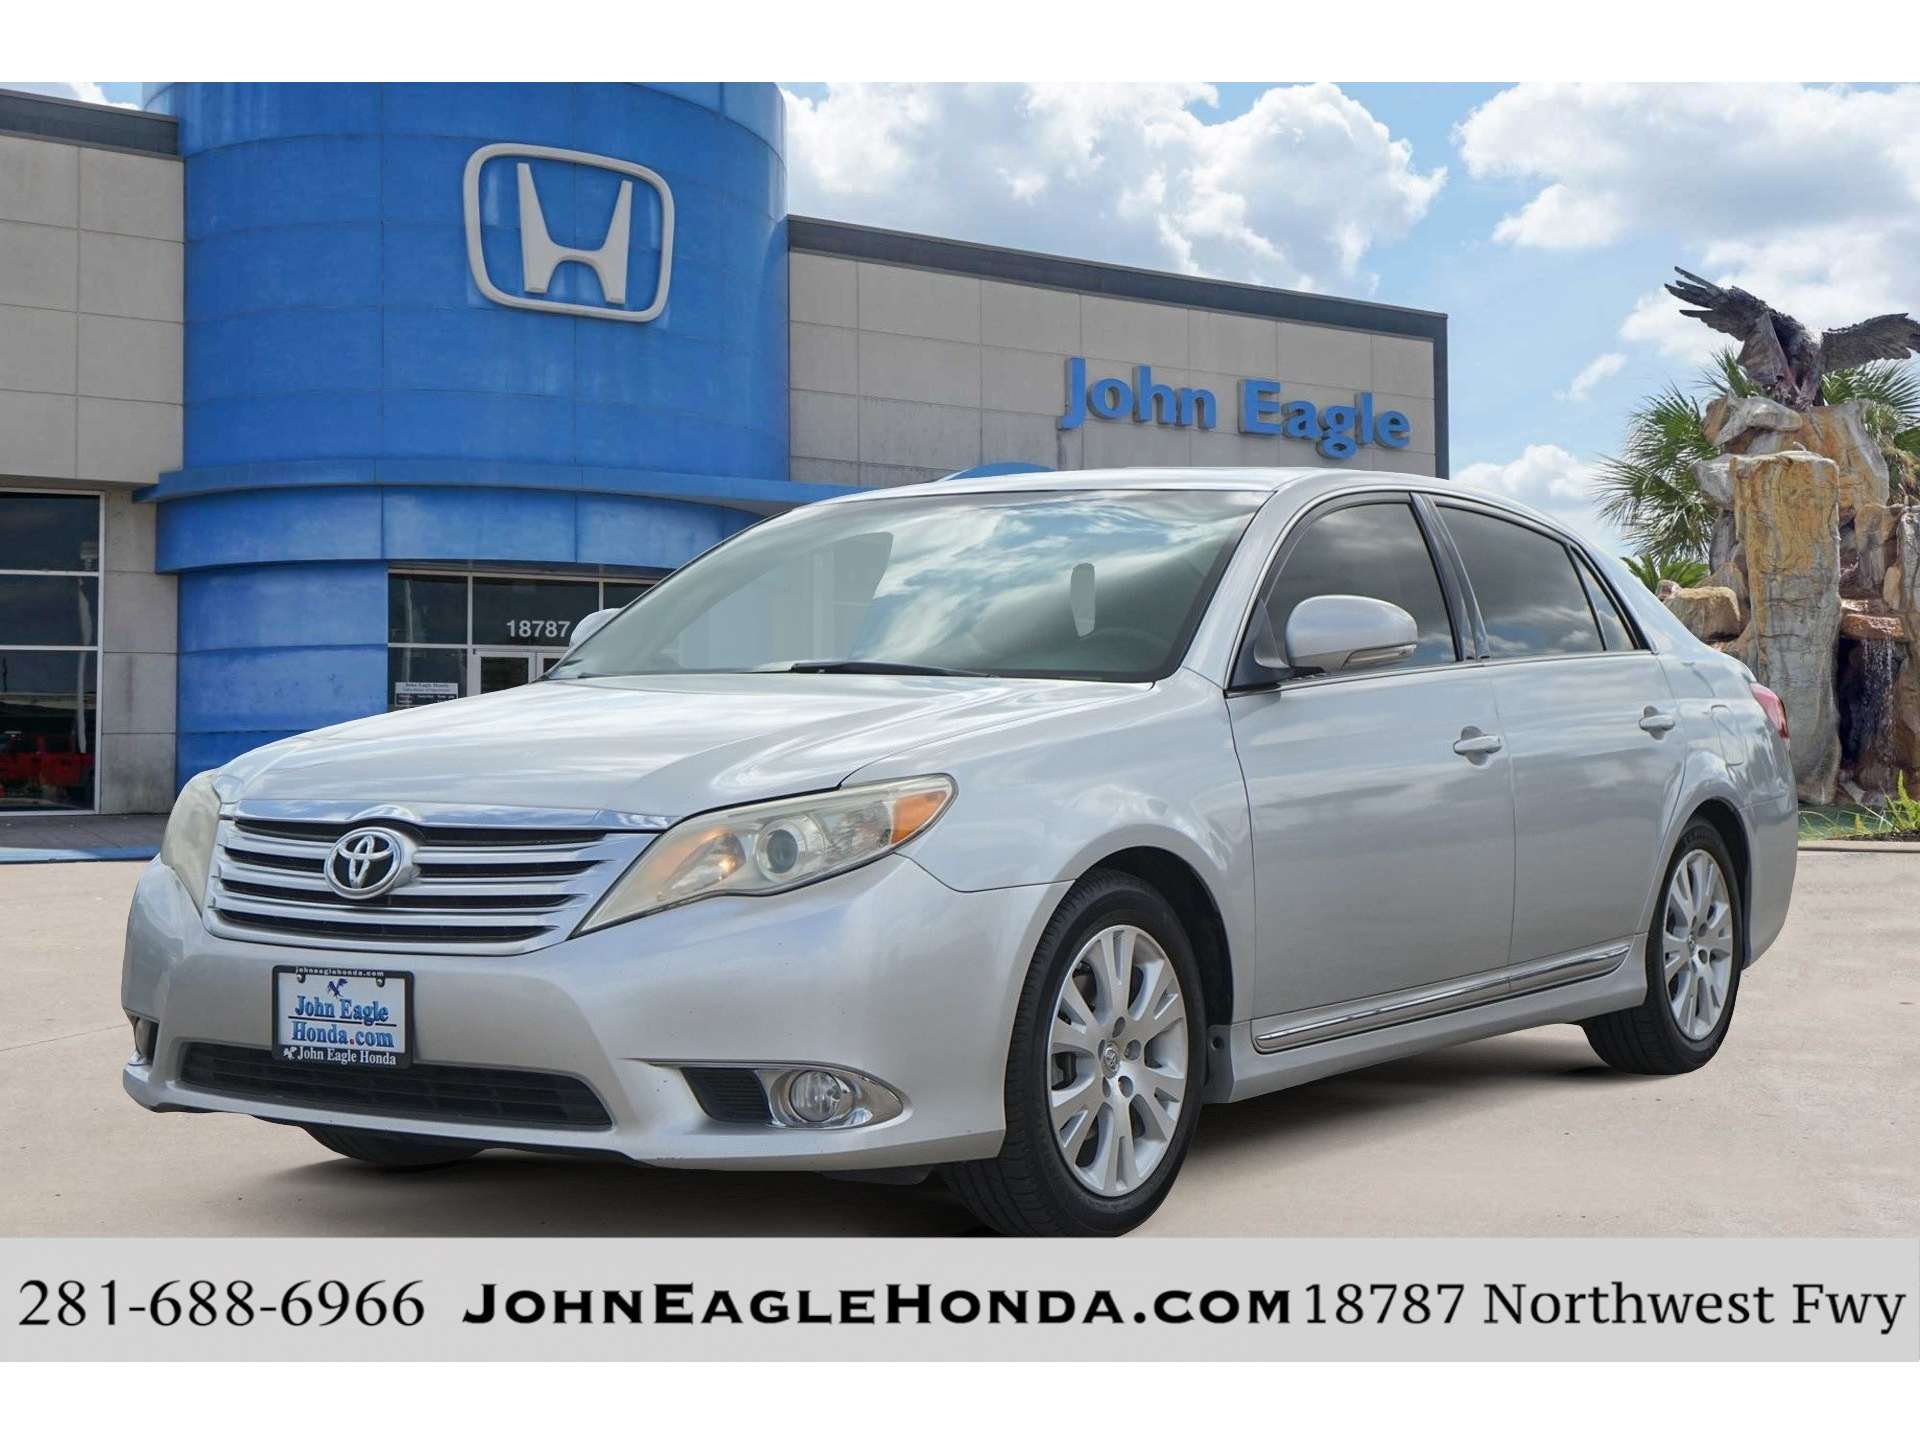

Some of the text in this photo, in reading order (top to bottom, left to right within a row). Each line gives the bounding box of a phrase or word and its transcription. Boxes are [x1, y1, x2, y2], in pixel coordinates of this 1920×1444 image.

[1056, 357, 1411, 460] John Eagle
[506, 620, 571, 638] 18787
[295, 995, 389, 1026] John Eagle
[292, 1020, 395, 1048] Honda.com
[297, 1046, 397, 1066] John Eagle Honda
